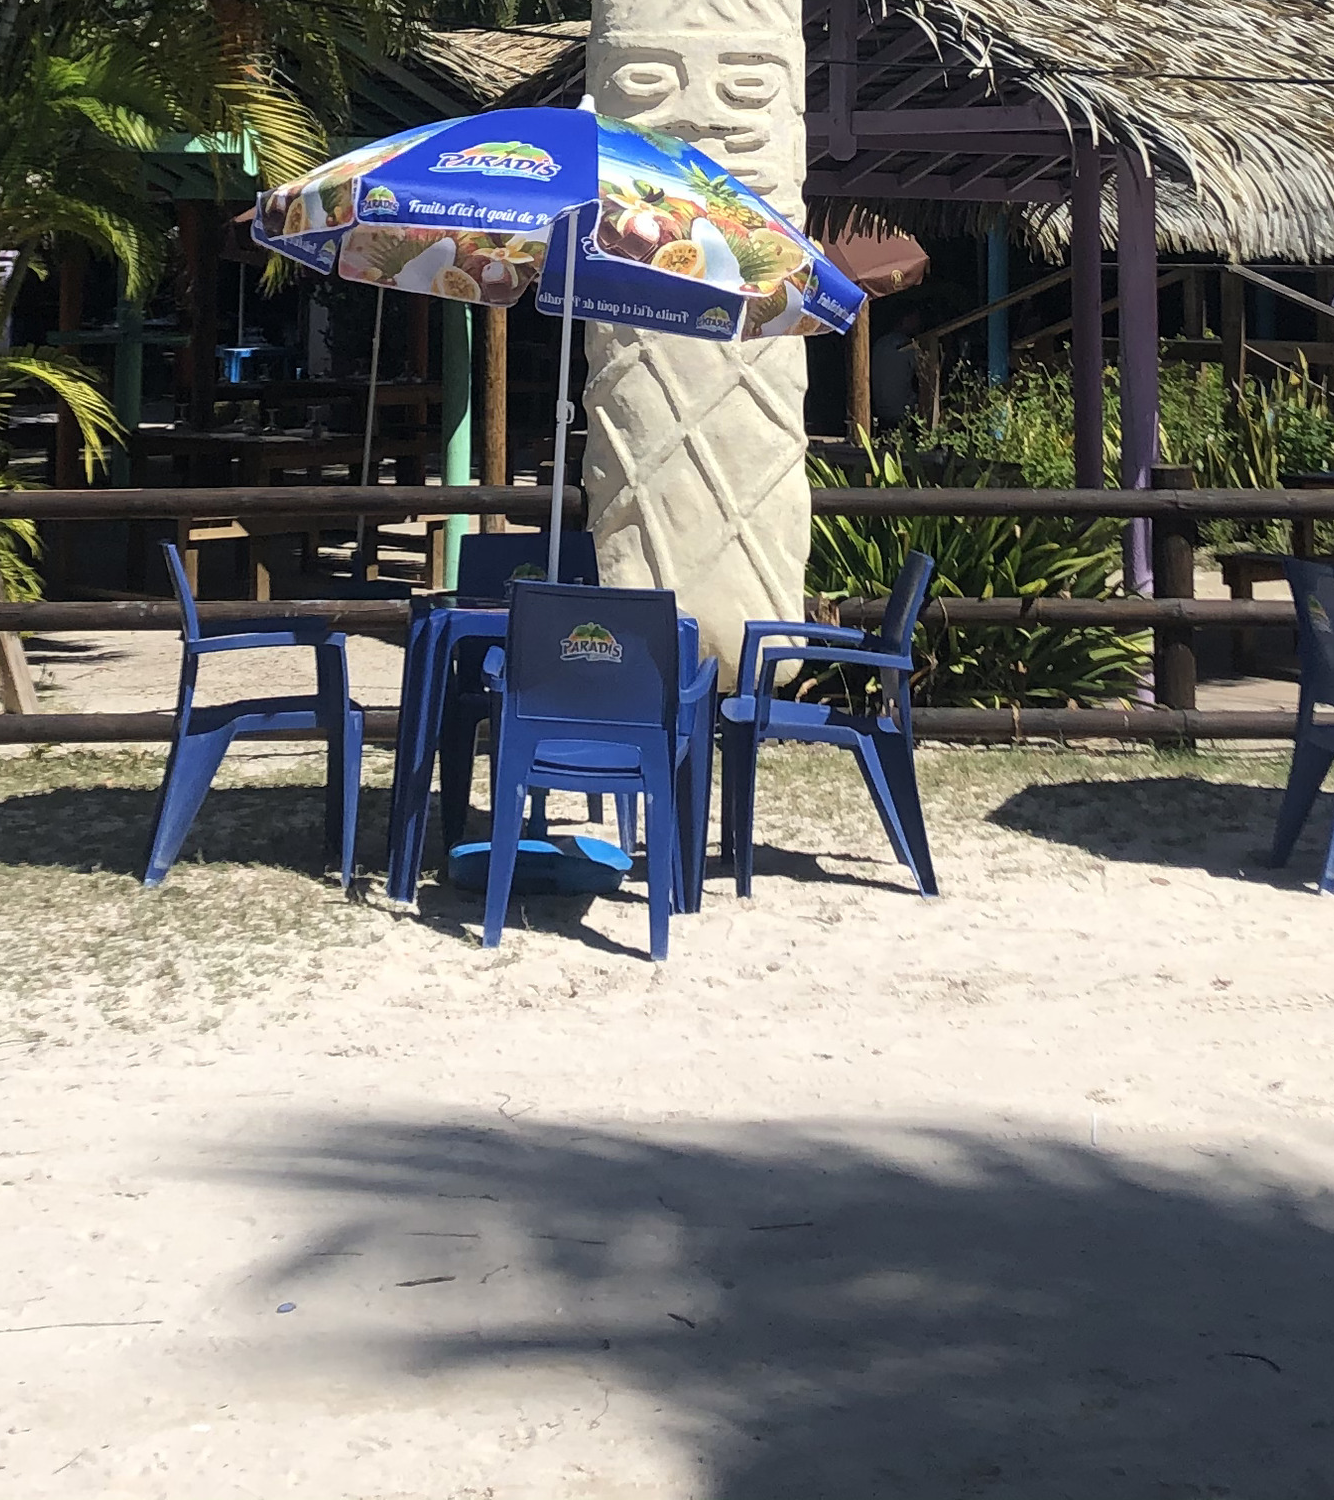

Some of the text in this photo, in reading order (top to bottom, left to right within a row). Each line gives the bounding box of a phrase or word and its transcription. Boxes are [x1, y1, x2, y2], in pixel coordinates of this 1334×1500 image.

[408, 199, 445, 215] Fruits
[447, 202, 475, 218] d'ici
[474, 206, 488, 219] et
[487, 208, 517, 223] goût
[517, 212, 533, 225] de
